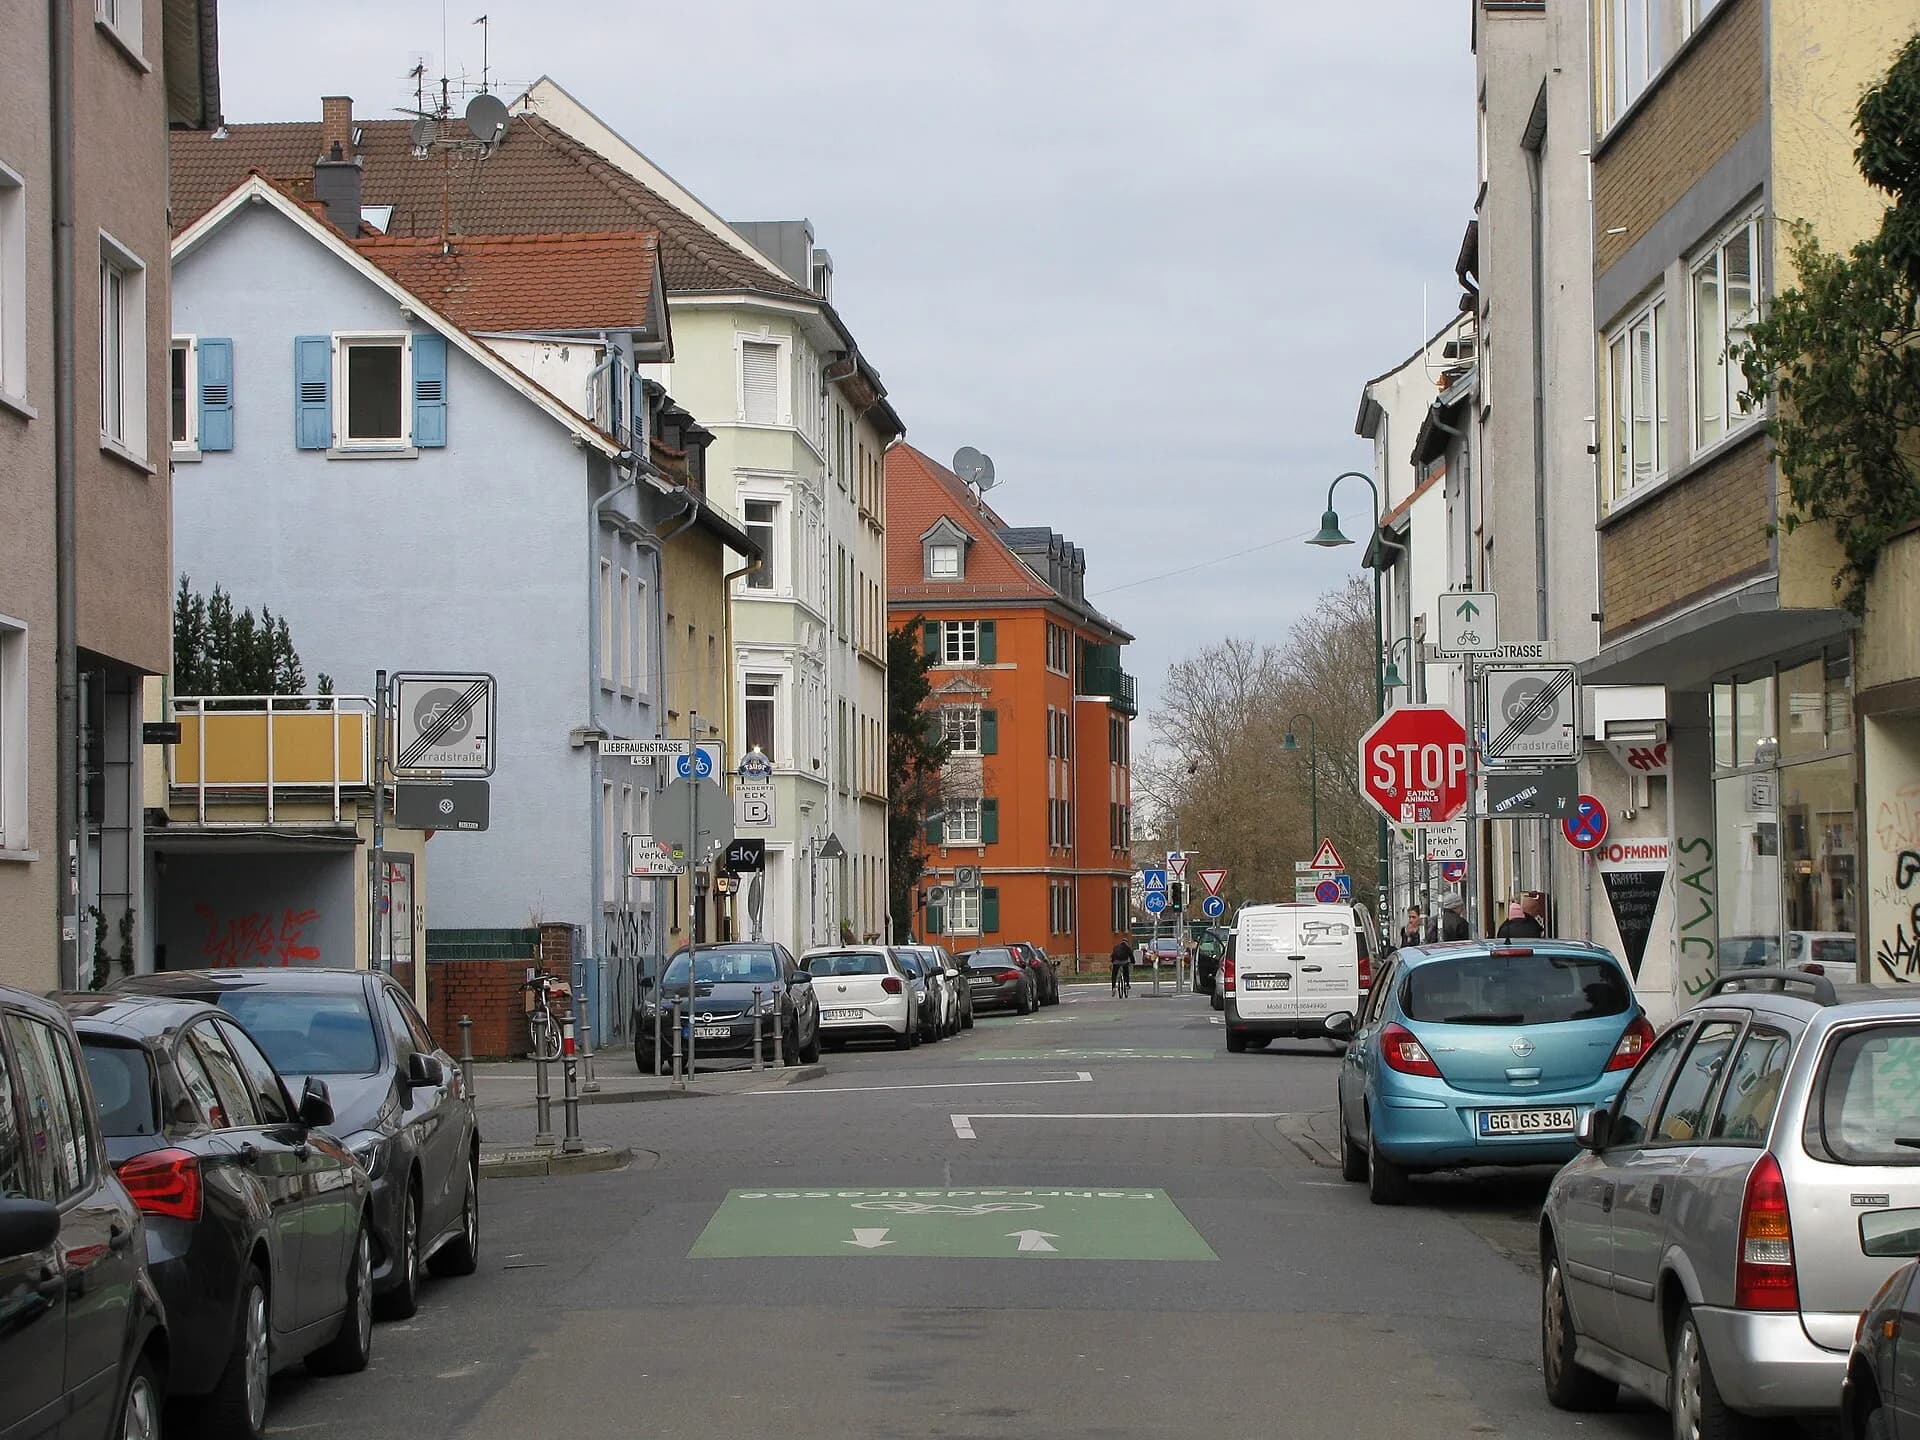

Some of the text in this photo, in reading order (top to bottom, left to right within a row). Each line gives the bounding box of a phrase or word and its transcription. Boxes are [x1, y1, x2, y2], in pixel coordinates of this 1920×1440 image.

[603, 742, 683, 753] LIEBFRAUENSTRASSE
[421, 752, 482, 762] rradstraße
[633, 756, 650, 765] 4-58
[1373, 744, 1466, 790] STOP
[1427, 835, 1459, 845] erkehr
[639, 850, 669, 860] verke
[730, 846, 760, 864] sky
[1432, 847, 1449, 857] frei
[1597, 844, 1668, 863] HOFMANN
[650, 861, 667, 870] frei
[715, 1027, 730, 1036] 222
[1490, 1111, 1572, 1129] GG GS 384
